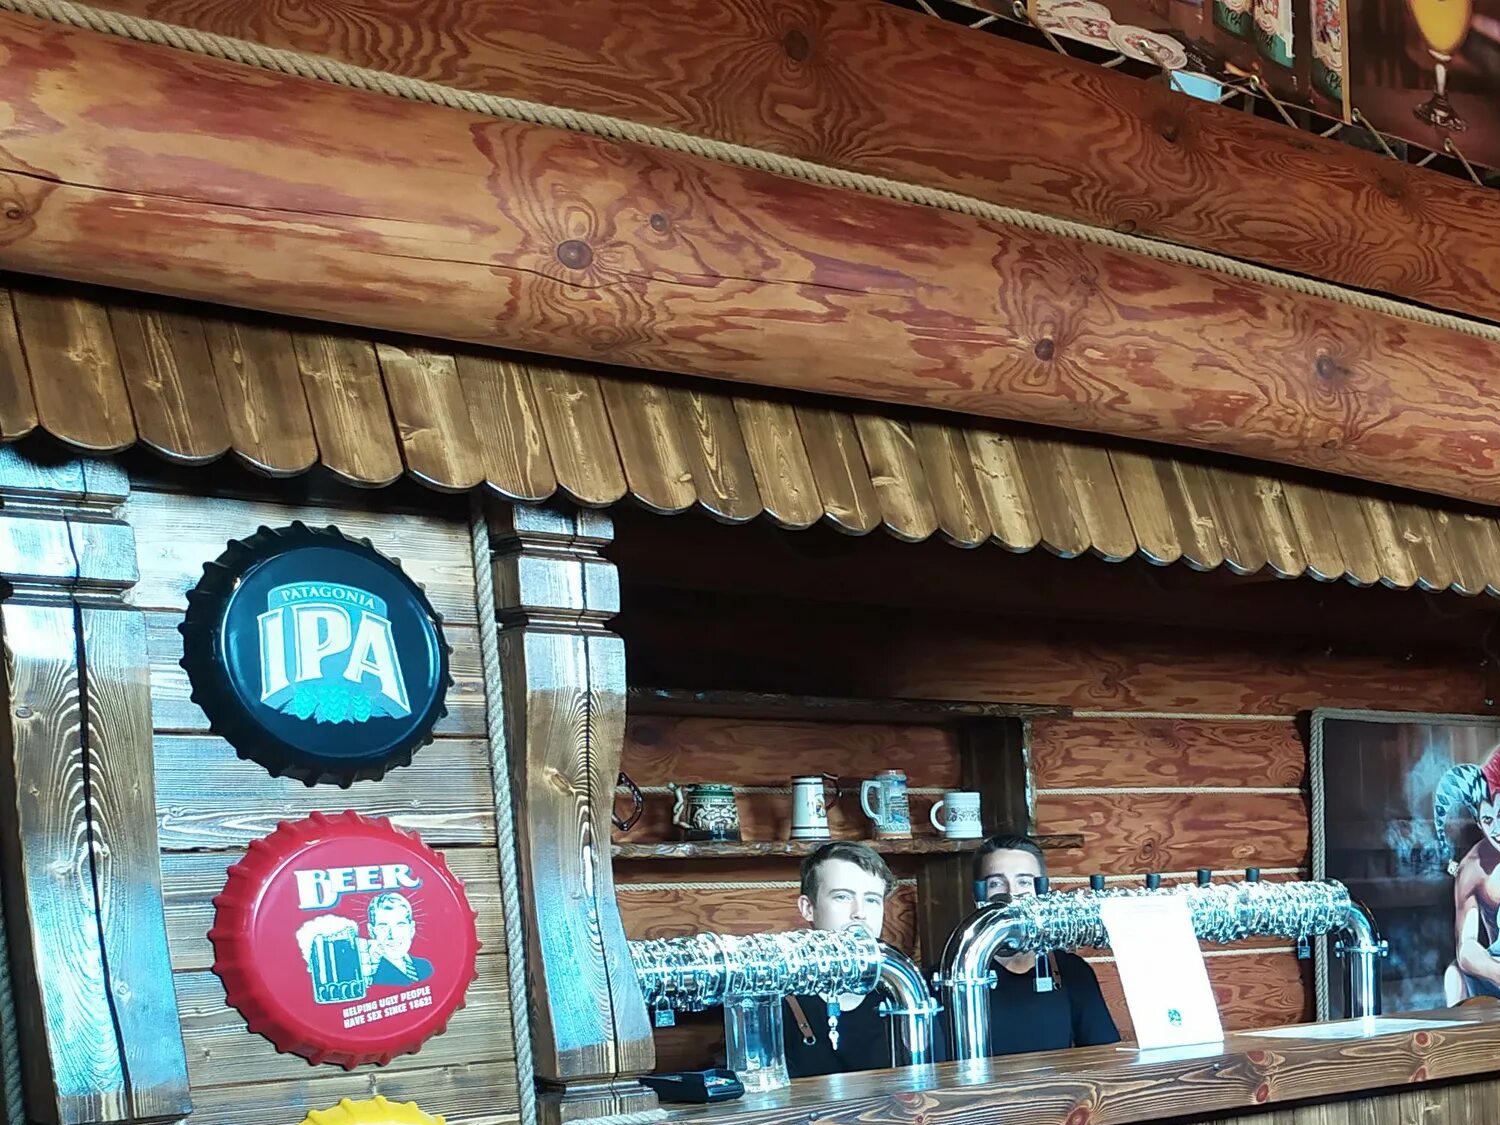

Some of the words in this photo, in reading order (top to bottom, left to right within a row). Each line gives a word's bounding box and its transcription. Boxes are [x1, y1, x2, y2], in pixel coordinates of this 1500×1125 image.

[281, 588, 375, 610] PATAGONIA
[257, 602, 411, 714] IPA
[294, 864, 420, 910] BEER
[343, 1000, 378, 1018] HELPING
[379, 994, 399, 1008] UGLY
[400, 985, 431, 1002] PEOPLE
[343, 1015, 366, 1029] HAVE
[366, 1009, 383, 1022] SEX
[384, 1003, 408, 1018] SINCE
[409, 995, 433, 1010] 1862!
